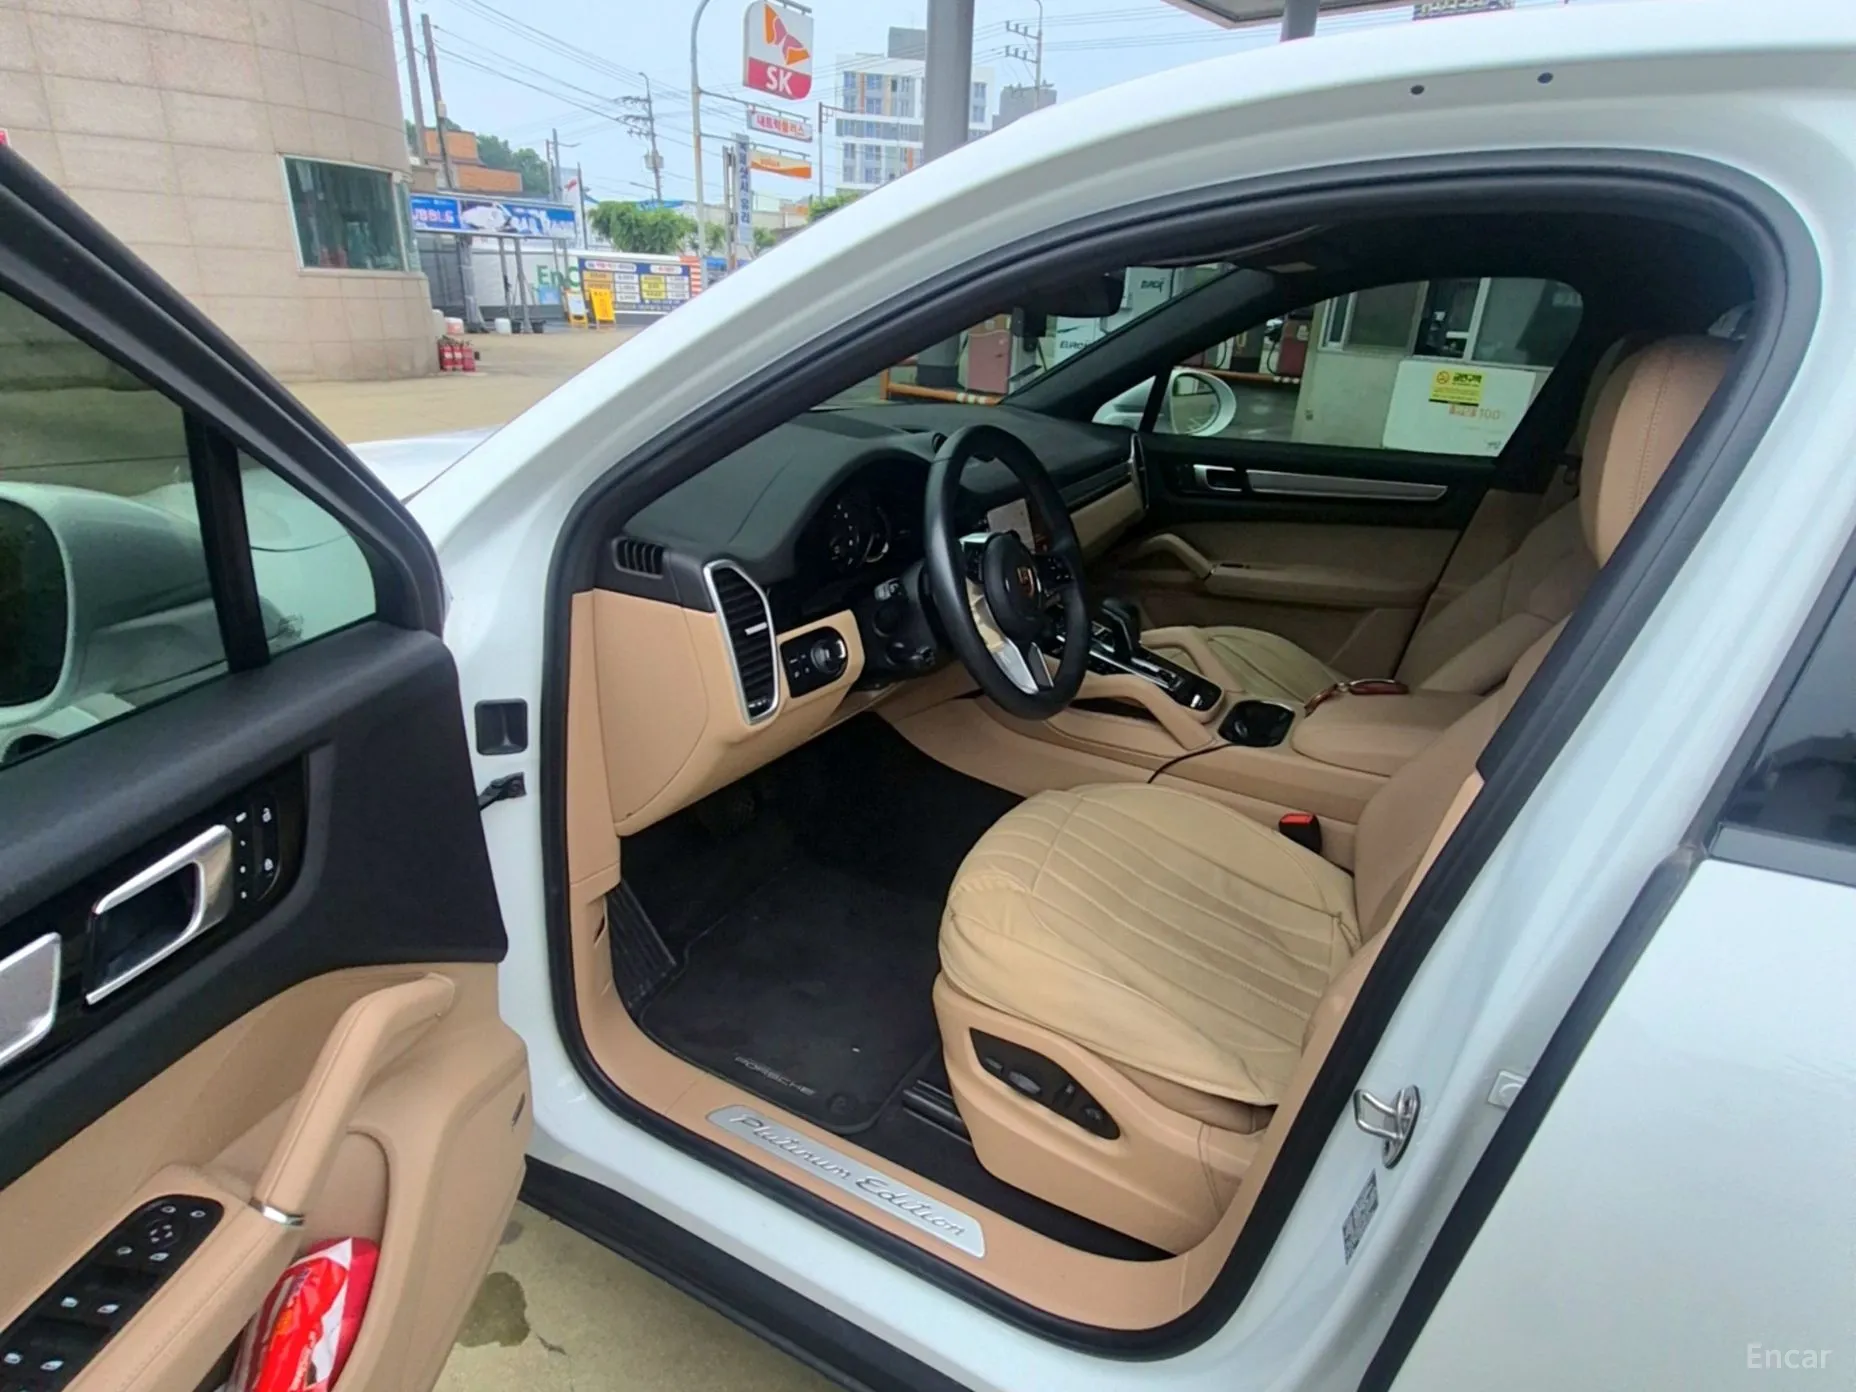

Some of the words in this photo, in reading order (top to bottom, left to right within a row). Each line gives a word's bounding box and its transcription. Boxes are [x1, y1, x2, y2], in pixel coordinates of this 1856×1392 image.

[765, 65, 793, 96] SK
[734, 1055, 816, 1096] PORSCHE
[730, 1113, 852, 1181] Platinum
[855, 1174, 965, 1236] Edition
